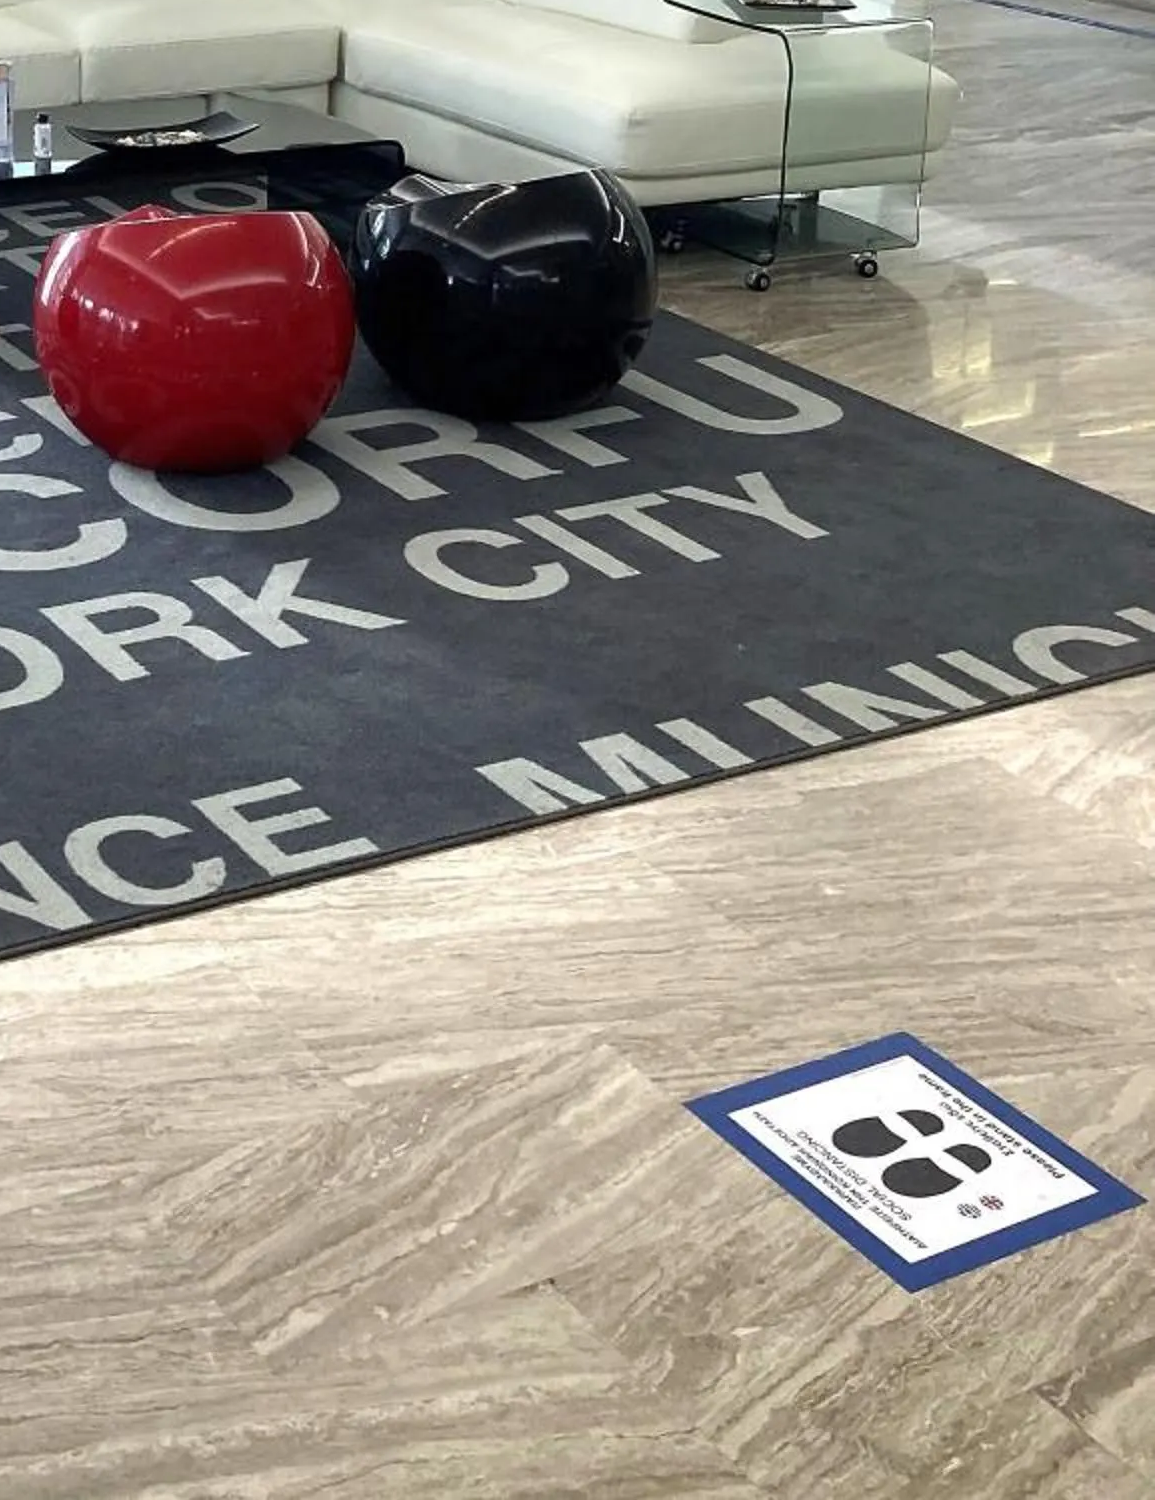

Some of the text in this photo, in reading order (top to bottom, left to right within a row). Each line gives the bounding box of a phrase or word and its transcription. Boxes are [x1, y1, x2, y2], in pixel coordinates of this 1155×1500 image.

[404, 471, 830, 601] CITY
[953, 1098, 973, 1112] the
[972, 1112, 987, 1123] in
[984, 1122, 1022, 1148] stand
[798, 1132, 911, 1220] SOCIAL DISTANCING
[1022, 1147, 1065, 1179] Please
